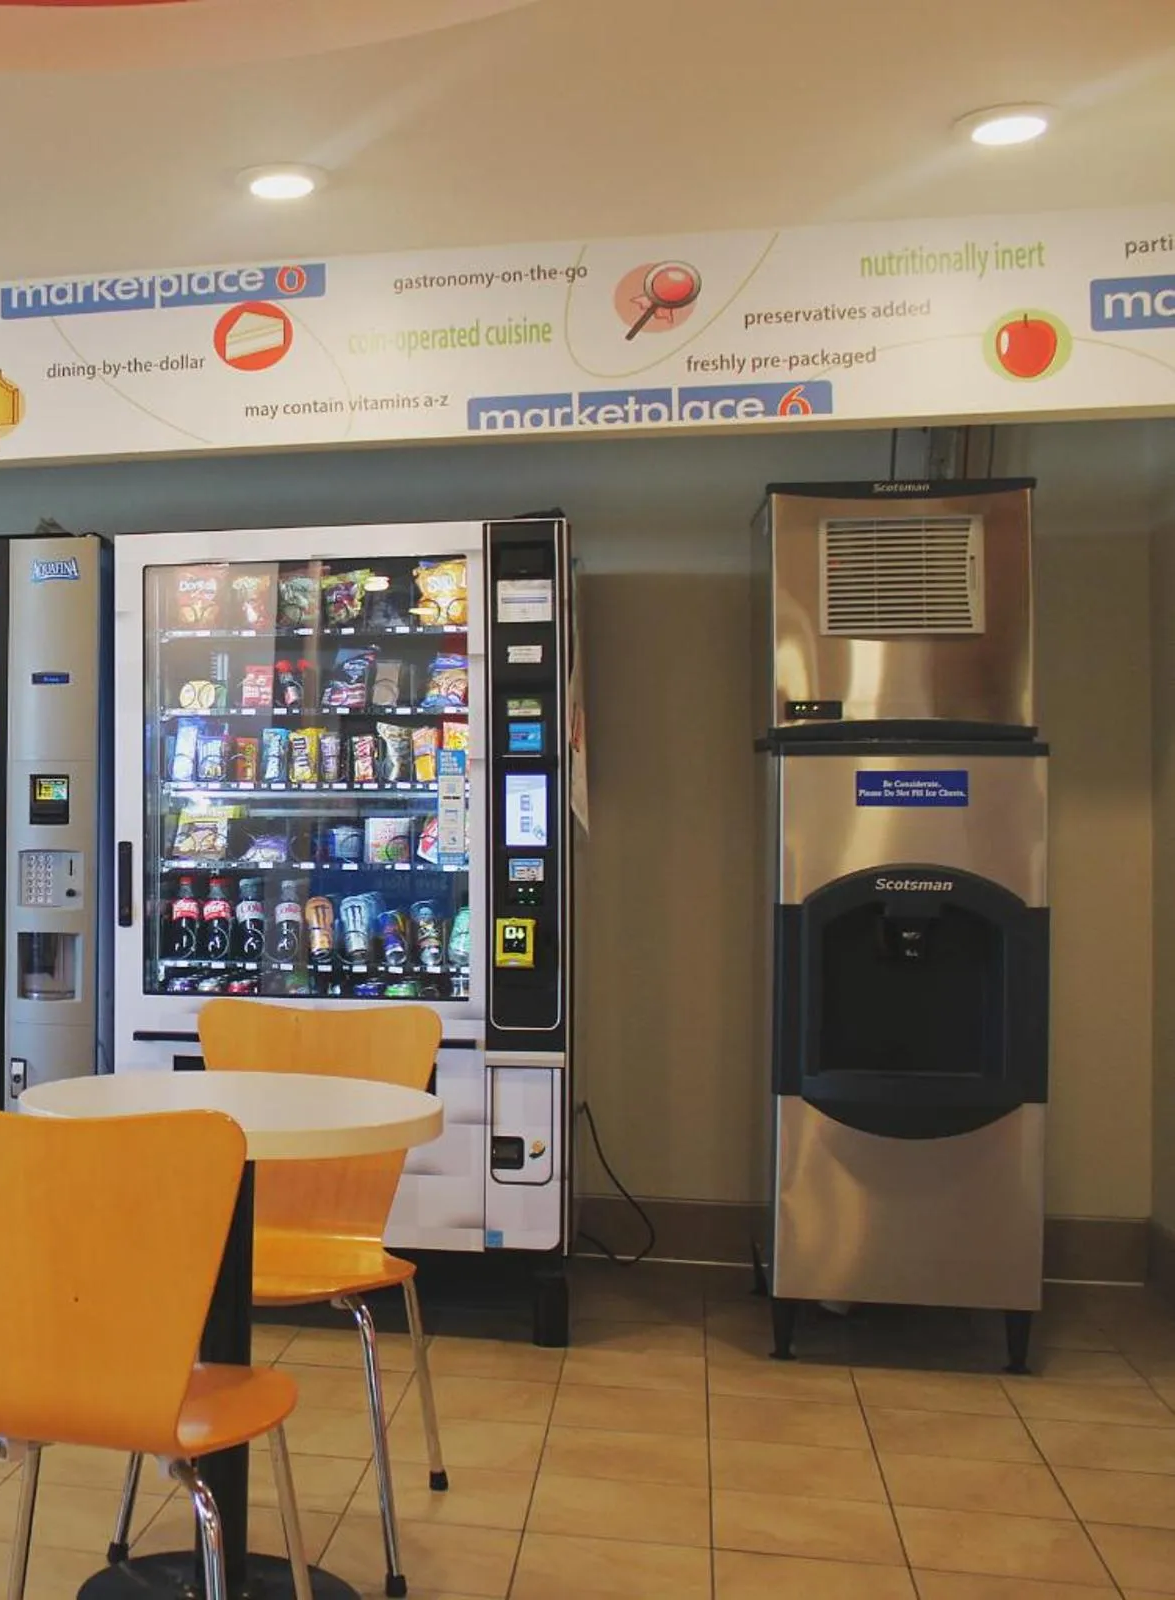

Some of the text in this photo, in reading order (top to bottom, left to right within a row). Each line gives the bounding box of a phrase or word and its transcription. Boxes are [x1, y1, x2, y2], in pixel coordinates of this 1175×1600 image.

[860, 241, 1046, 279] nutritionally inert
[393, 264, 588, 294] gastronomy-on-the-go
[743, 301, 931, 329] preservatives added
[348, 318, 553, 357] coin-operated cuisine
[46, 355, 206, 380] dining-by-the-dollar
[685, 347, 877, 375] freshly pre-packaged
[245, 395, 449, 419] may contain vitamins a-z
[479, 385, 813, 428] marketplace 6
[872, 482, 930, 494] Scotsman
[33, 557, 79, 577] AQUAFINA
[875, 877, 953, 892] Scotsman
